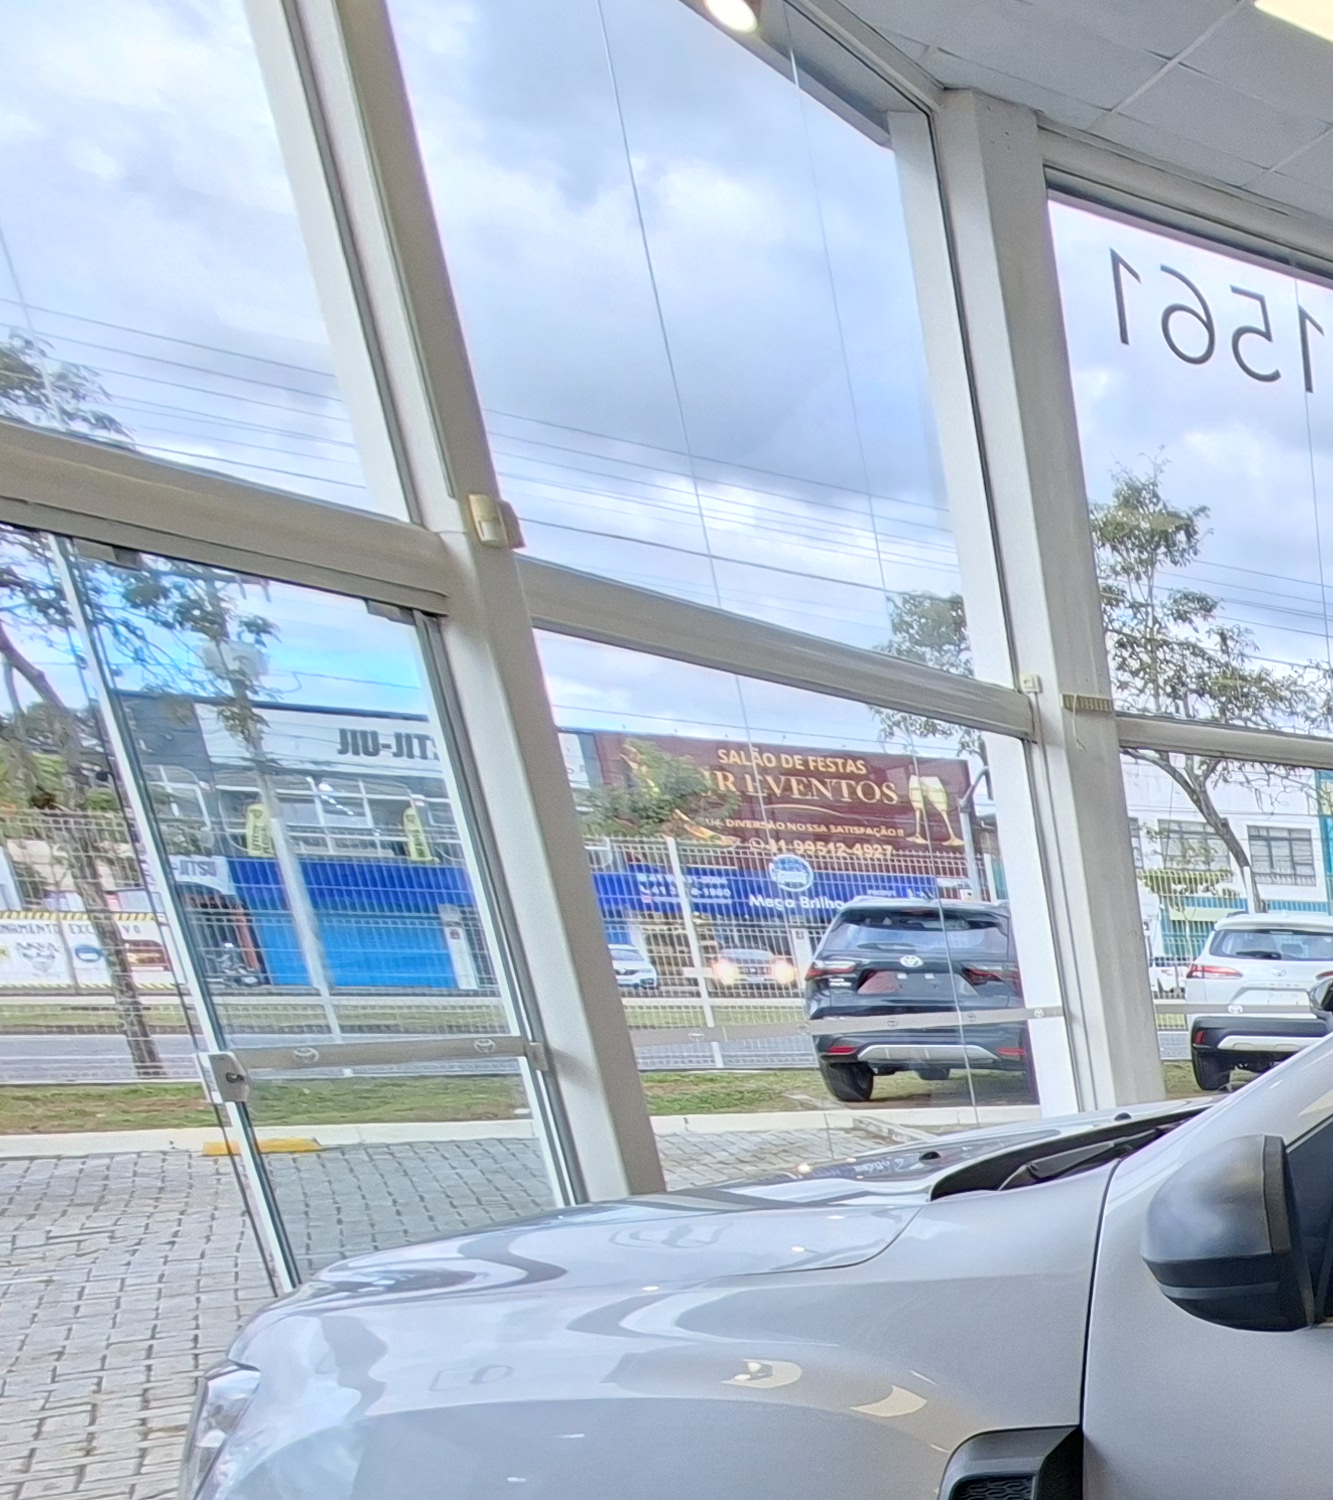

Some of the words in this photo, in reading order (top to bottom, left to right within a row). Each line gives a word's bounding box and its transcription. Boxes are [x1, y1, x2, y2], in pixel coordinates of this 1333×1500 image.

[718, 746, 777, 768] SALÃO
[781, 754, 804, 769] DE
[808, 756, 867, 775] FESTAS
[746, 772, 898, 805] EVENTOS
[787, 821, 828, 833] NOSSA
[749, 894, 795, 911] Mega
[799, 895, 844, 910] Brilho
